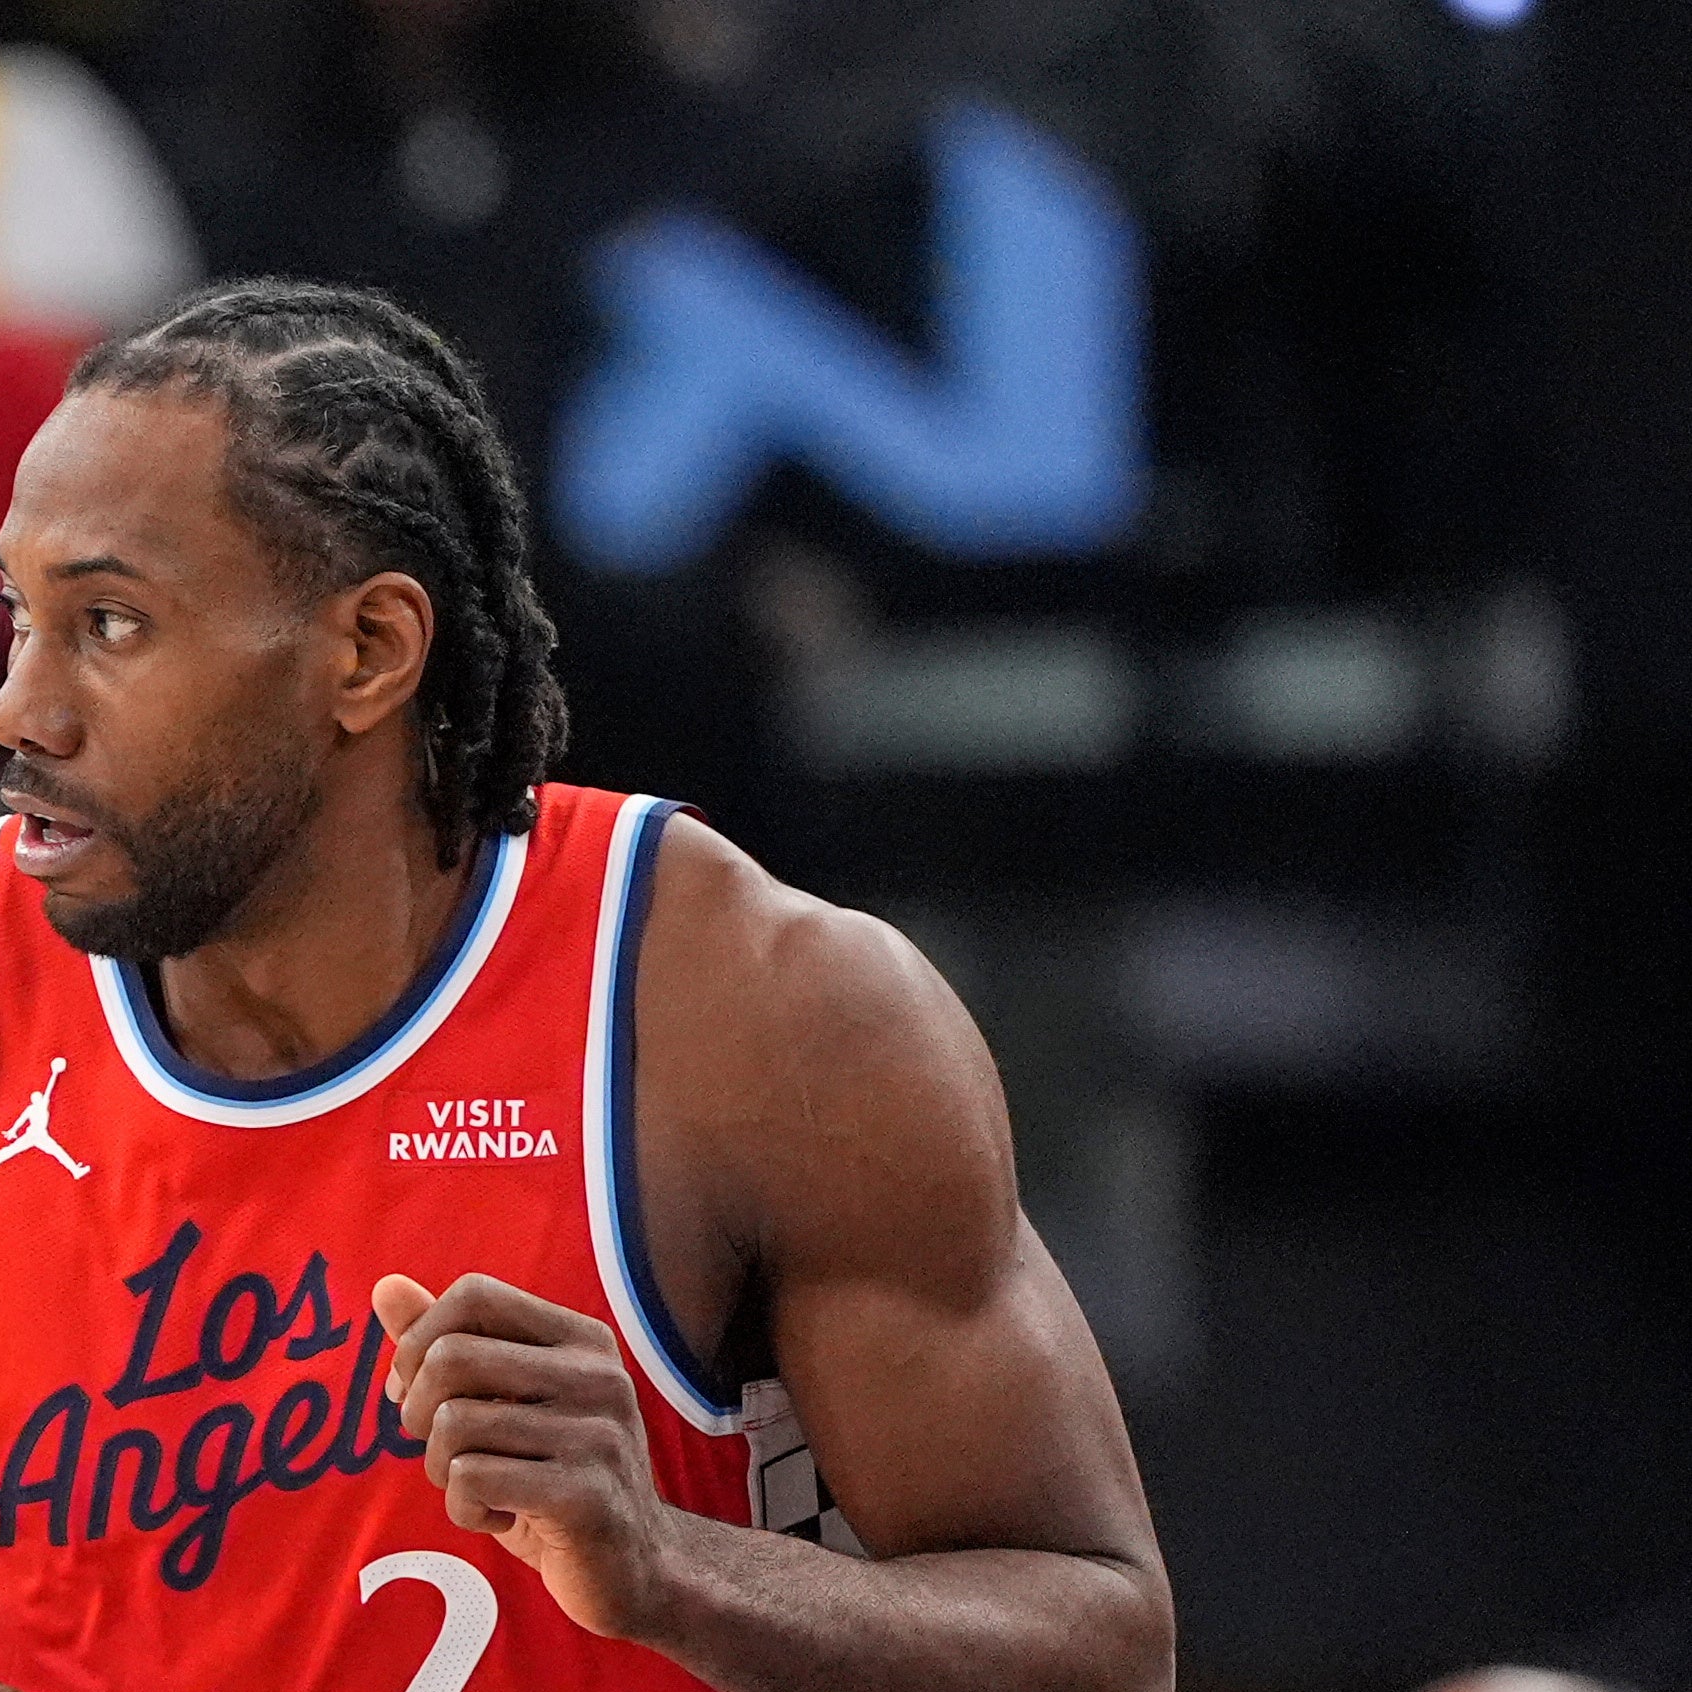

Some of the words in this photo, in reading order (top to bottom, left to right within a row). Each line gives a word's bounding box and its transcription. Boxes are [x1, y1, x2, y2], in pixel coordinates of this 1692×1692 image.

[426, 1098, 527, 1129] VISIT
[388, 1129, 559, 1161] RWANDA
[105, 1219, 351, 1408] Los
